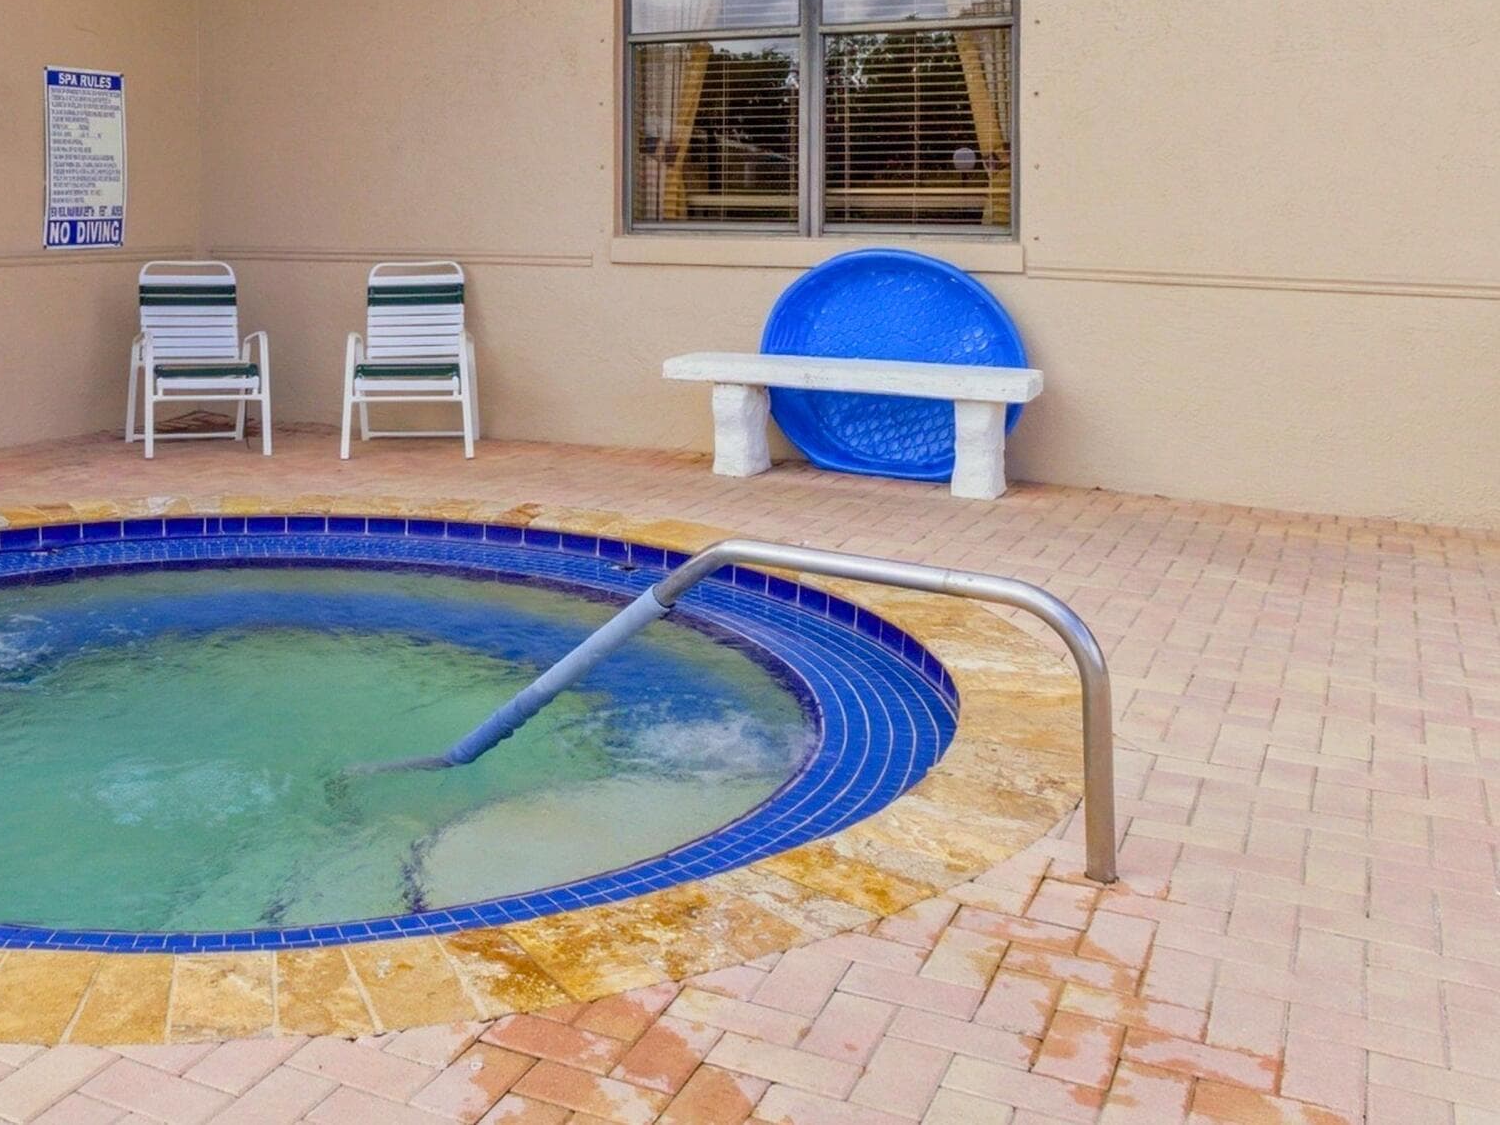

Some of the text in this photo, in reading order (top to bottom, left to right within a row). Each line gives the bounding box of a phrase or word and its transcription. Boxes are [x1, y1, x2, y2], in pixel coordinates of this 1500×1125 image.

[58, 73, 112, 89] SPA RULES
[49, 220, 120, 244] NO DIVING
